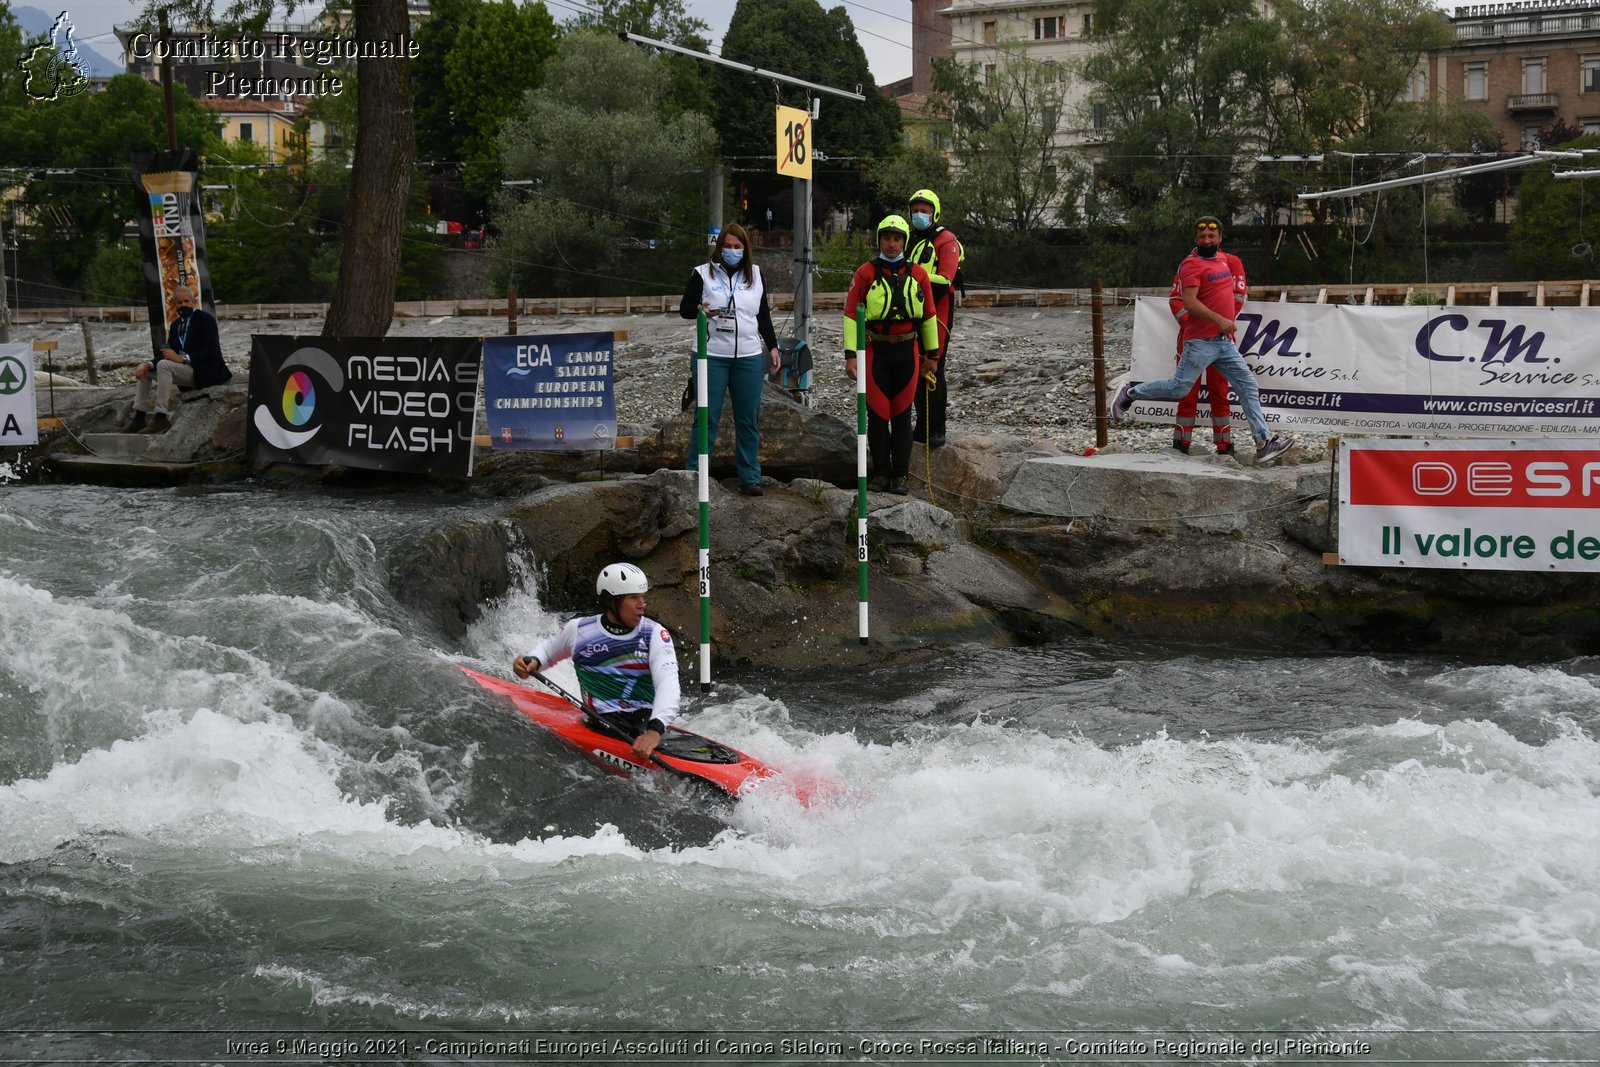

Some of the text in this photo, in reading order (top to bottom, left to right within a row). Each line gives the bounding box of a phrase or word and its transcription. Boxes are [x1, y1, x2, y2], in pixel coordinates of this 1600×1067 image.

[785, 121, 805, 165] 18
[163, 192, 181, 237] KIND
[517, 344, 552, 367] ECA
[567, 351, 610, 363] CANOE
[348, 355, 450, 382] MEDIA
[556, 365, 607, 377] SLALOM
[1479, 360, 1578, 386] Service
[536, 381, 605, 393] EUROPEAN
[350, 390, 450, 418] VIDEO
[496, 397, 603, 409] CHAMPIONSHIPS
[1134, 406, 1176, 417] GLOBAL
[1423, 399, 1595, 414] www.cmservicesrl.it
[2, 413, 22, 436] A
[1286, 415, 1349, 427] SANIFICAZIONE
[1355, 419, 1400, 429] LOGISTICA
[1407, 421, 1451, 430] VIGILANZA
[1458, 423, 1534, 433] PROGETTAZIONE
[1540, 425, 1576, 433] EDILIZIA
[348, 423, 453, 453] FLASH
[1382, 526, 1600, 560] Il valore de
[587, 644, 609, 653] ECA
